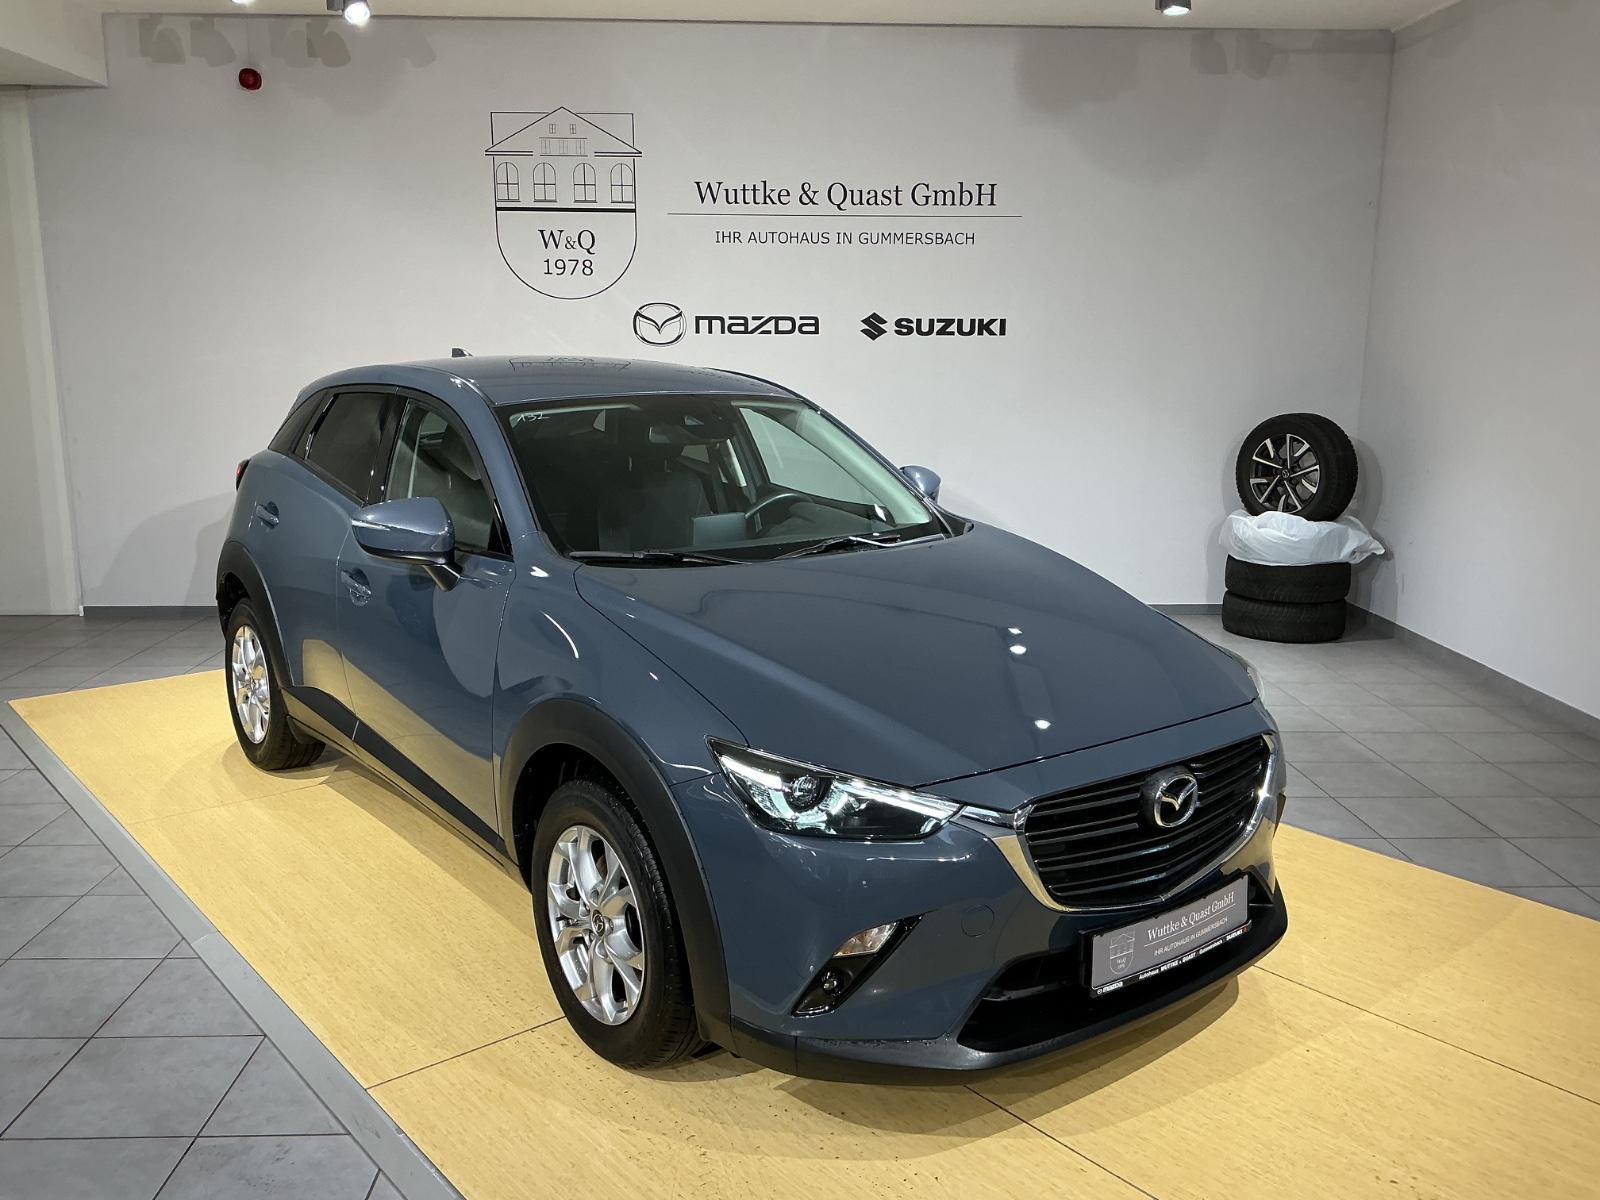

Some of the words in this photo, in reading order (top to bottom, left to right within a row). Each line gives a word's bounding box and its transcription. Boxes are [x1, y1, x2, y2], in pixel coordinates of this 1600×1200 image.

[693, 179, 791, 206] Wuttke
[798, 181, 820, 206] &
[827, 182, 903, 212] Quast
[910, 181, 998, 207] GmbH
[537, 229, 596, 255] W&Q
[715, 230, 743, 244] IHR
[747, 231, 830, 245] AUTOHAUS
[836, 231, 852, 245] IN
[858, 231, 975, 246] GUMMERSBACH
[543, 258, 594, 277] 1978
[894, 318, 1007, 337] SUZUKI
[1147, 920, 1180, 941] Wuttke
[1180, 916, 1188, 928] &
[1188, 906, 1211, 926] Quast
[1211, 891, 1235, 913] GmbH
[1164, 937, 1190, 954] AUTOHAUS
